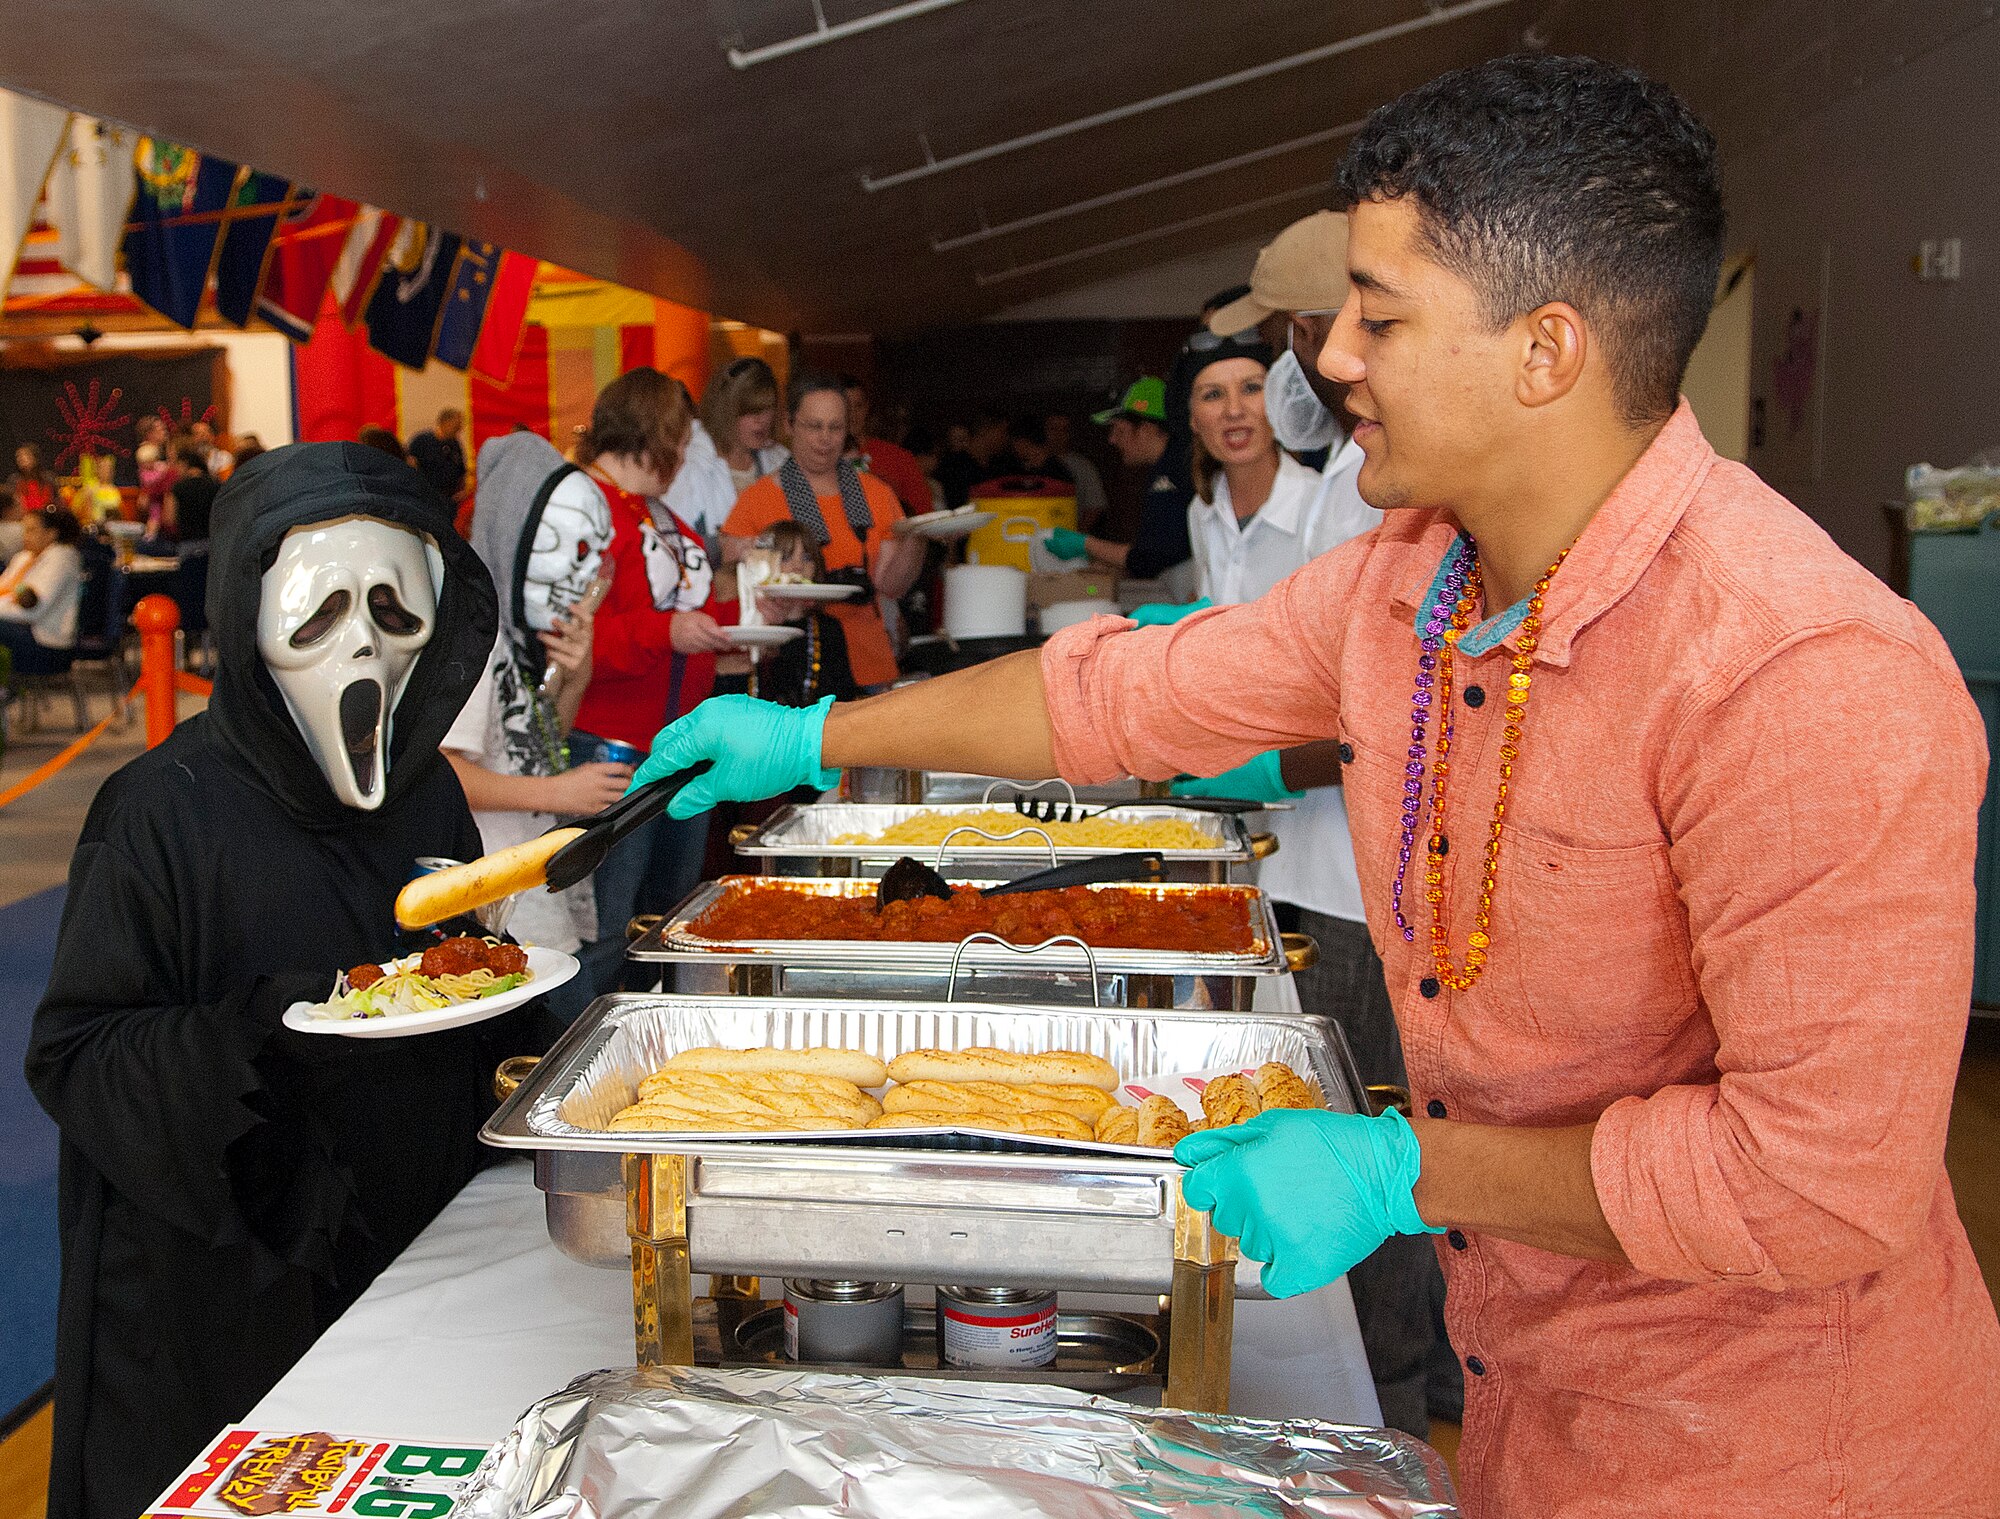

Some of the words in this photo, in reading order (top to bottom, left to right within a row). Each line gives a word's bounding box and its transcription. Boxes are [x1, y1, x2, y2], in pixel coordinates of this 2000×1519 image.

[188, 1443, 242, 1493] 2013
[221, 1436, 316, 1511] FRENZY
[286, 1439, 371, 1512] FOOTBALL
[336, 1453, 381, 1503] GAME
